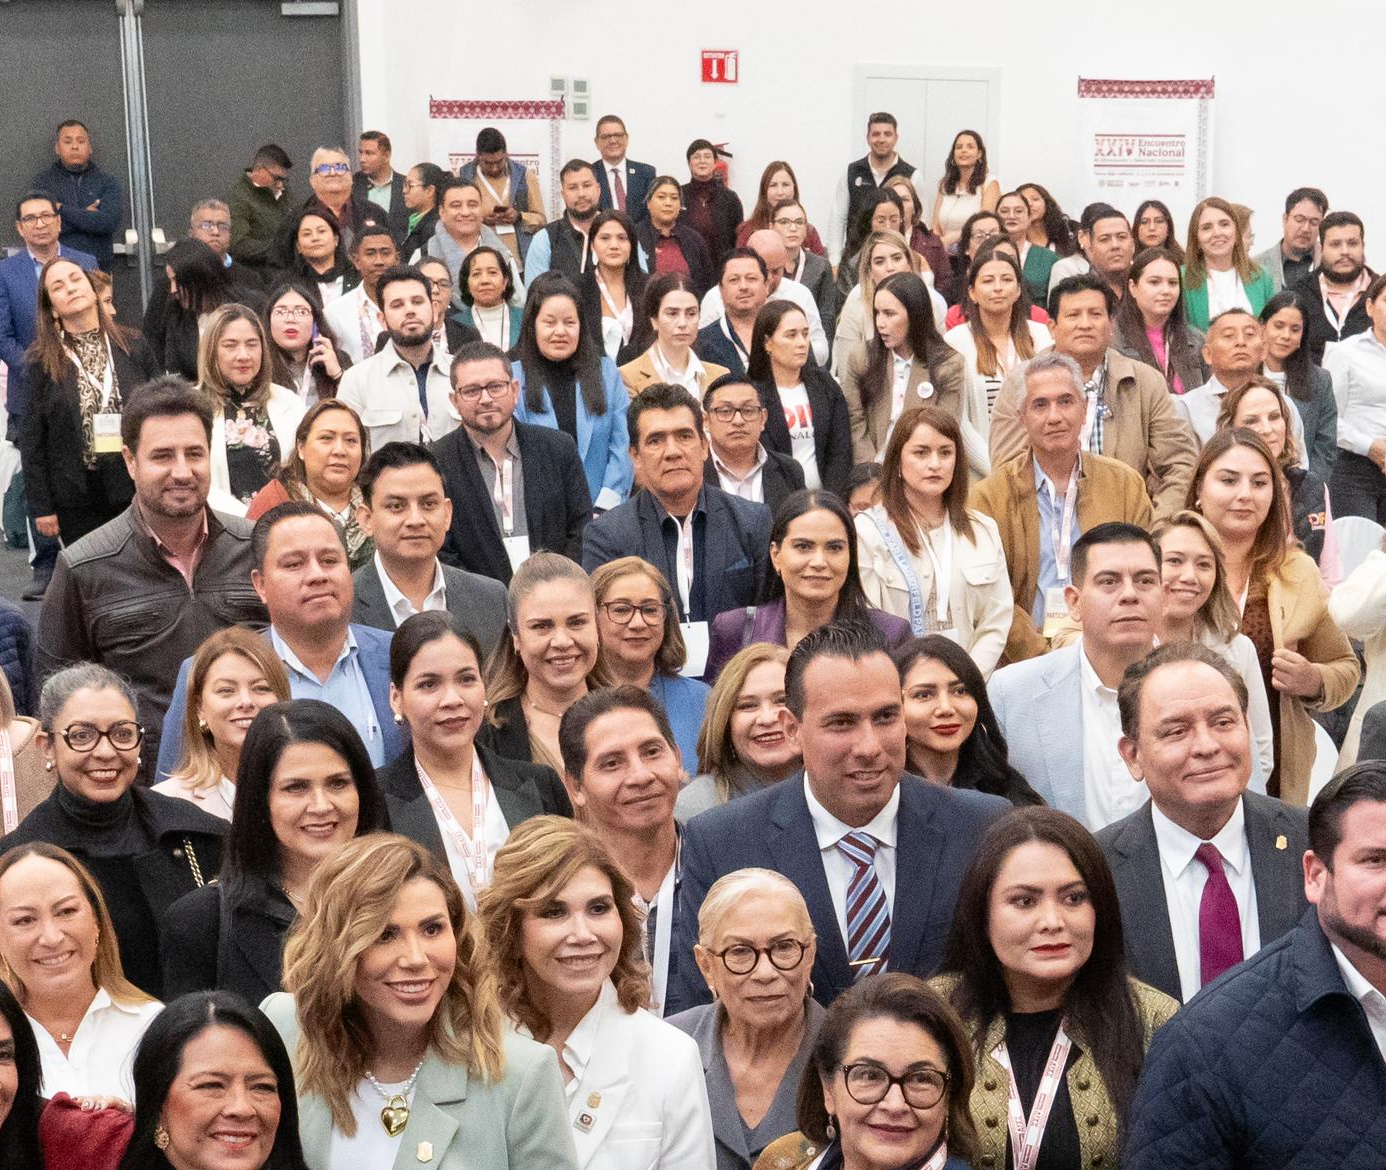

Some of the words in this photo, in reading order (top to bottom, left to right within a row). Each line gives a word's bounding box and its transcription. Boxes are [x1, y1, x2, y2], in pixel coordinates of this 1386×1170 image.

[1094, 138, 1136, 157] XXIV
[1138, 139, 1186, 148] Encuentro
[1138, 148, 1185, 157] Nacional
